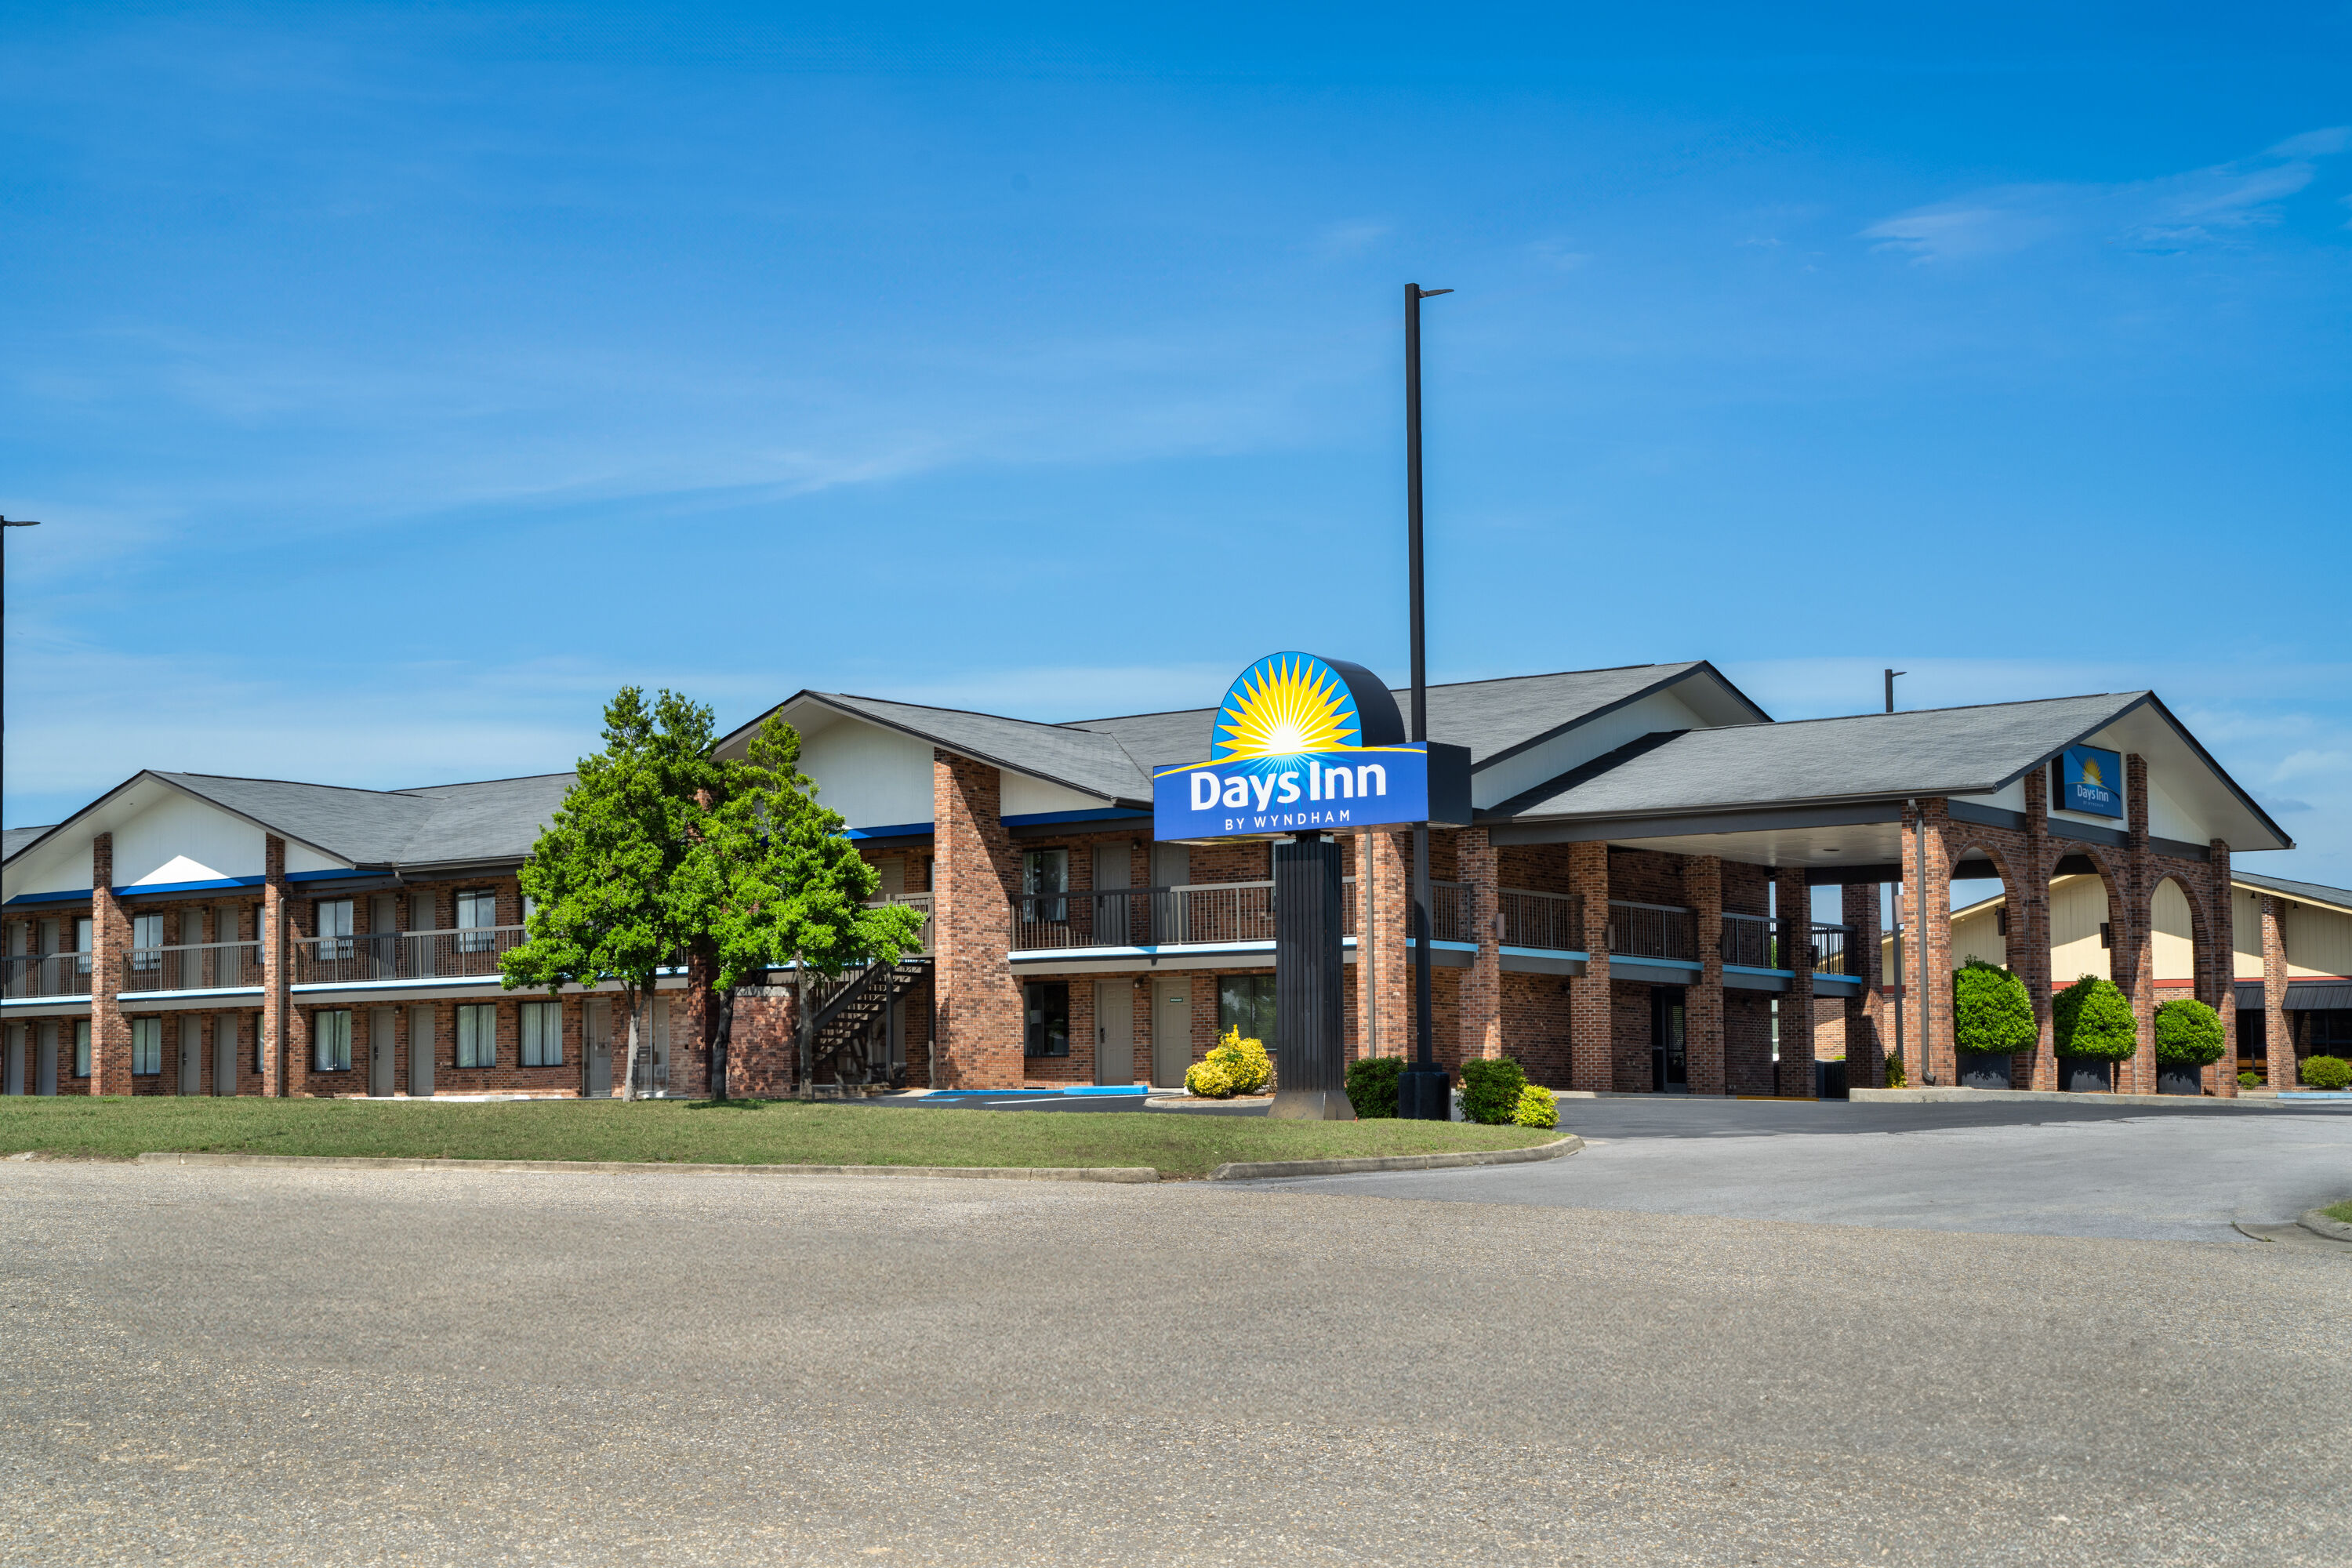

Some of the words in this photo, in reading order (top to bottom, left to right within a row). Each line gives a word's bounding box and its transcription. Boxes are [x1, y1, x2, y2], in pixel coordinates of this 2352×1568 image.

[1191, 771, 1301, 812] Days
[1309, 761, 1386, 800] Inn
[2077, 784, 2096, 800] Days
[2096, 787, 2109, 802] Inn
[1225, 818, 1245, 830] BY
[1254, 809, 1350, 828] WYNDHAM
